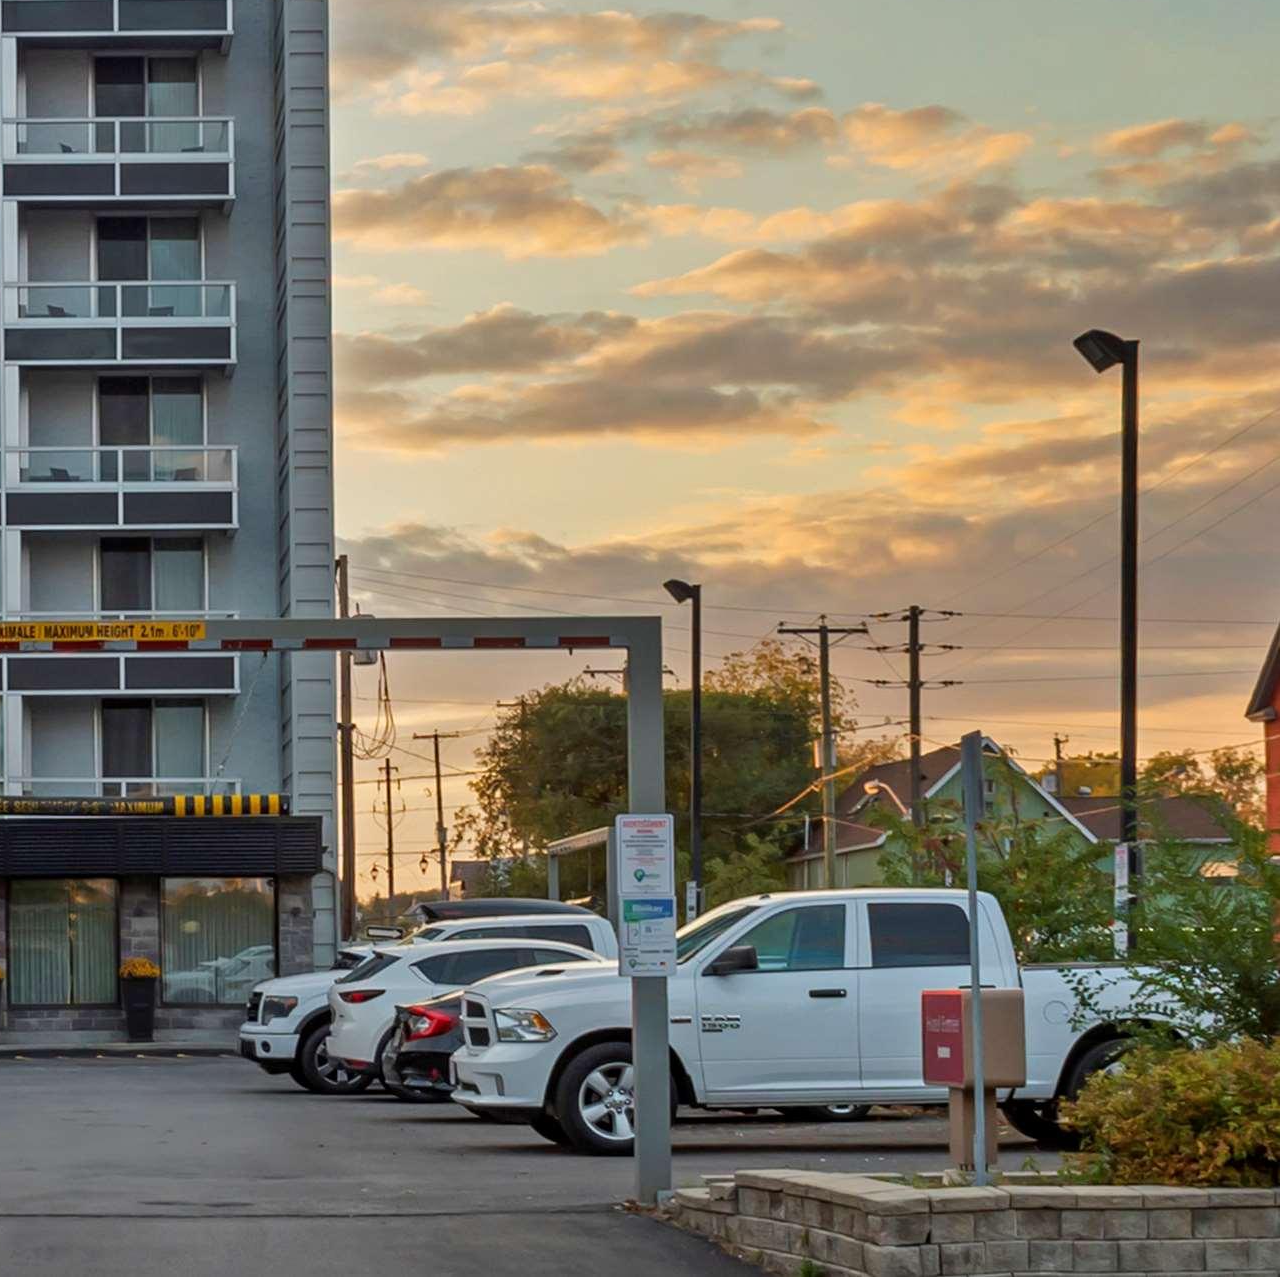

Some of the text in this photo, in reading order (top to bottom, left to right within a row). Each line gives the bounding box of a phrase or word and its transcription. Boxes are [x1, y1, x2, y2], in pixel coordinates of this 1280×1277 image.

[44, 626, 94, 639] MAXIMUM
[97, 625, 135, 638] HEIGHT
[141, 625, 165, 638] 2.1m
